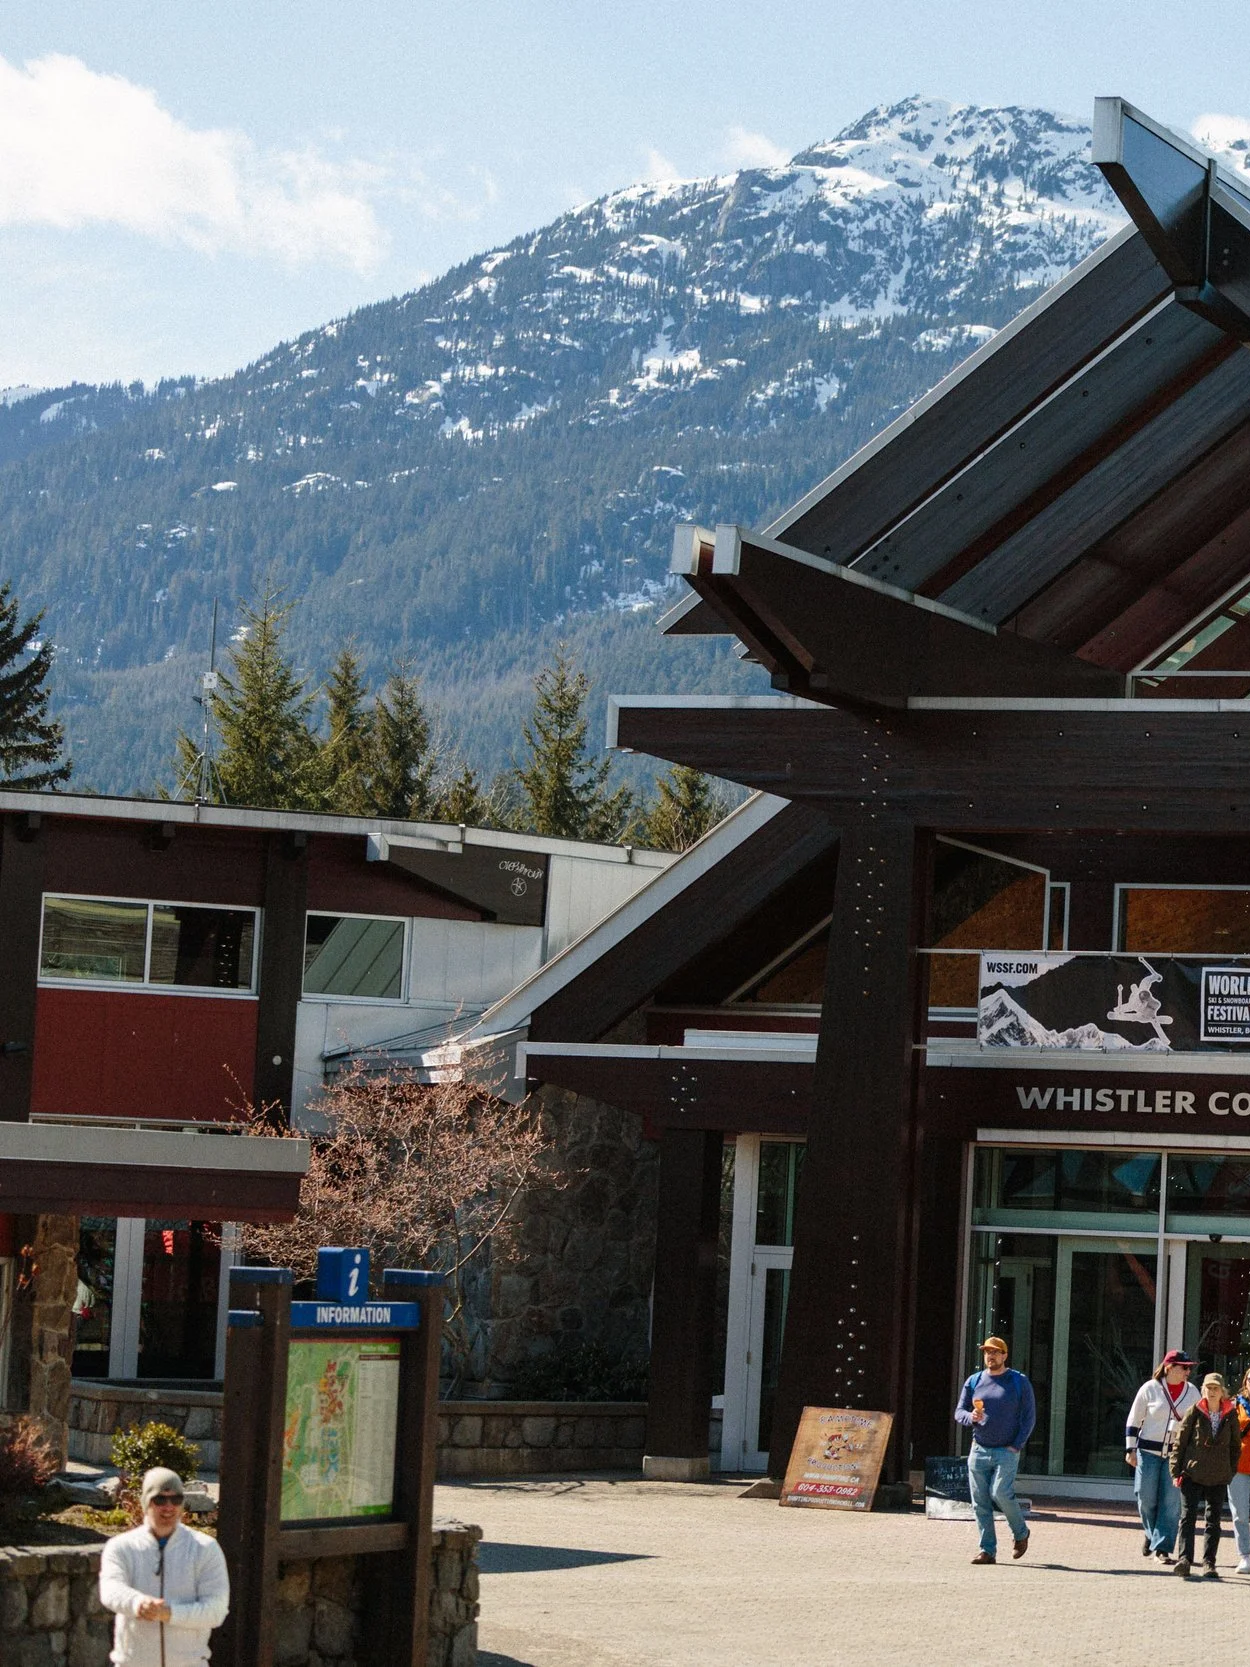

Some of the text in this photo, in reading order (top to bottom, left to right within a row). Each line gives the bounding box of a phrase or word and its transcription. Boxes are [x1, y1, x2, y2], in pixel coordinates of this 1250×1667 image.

[987, 961, 1038, 974] WSSF.COM
[1208, 1026, 1244, 1035] WHISTLER,
[1016, 1086, 1197, 1114] WHISTLER
[316, 1306, 391, 1324] INFORMATION
